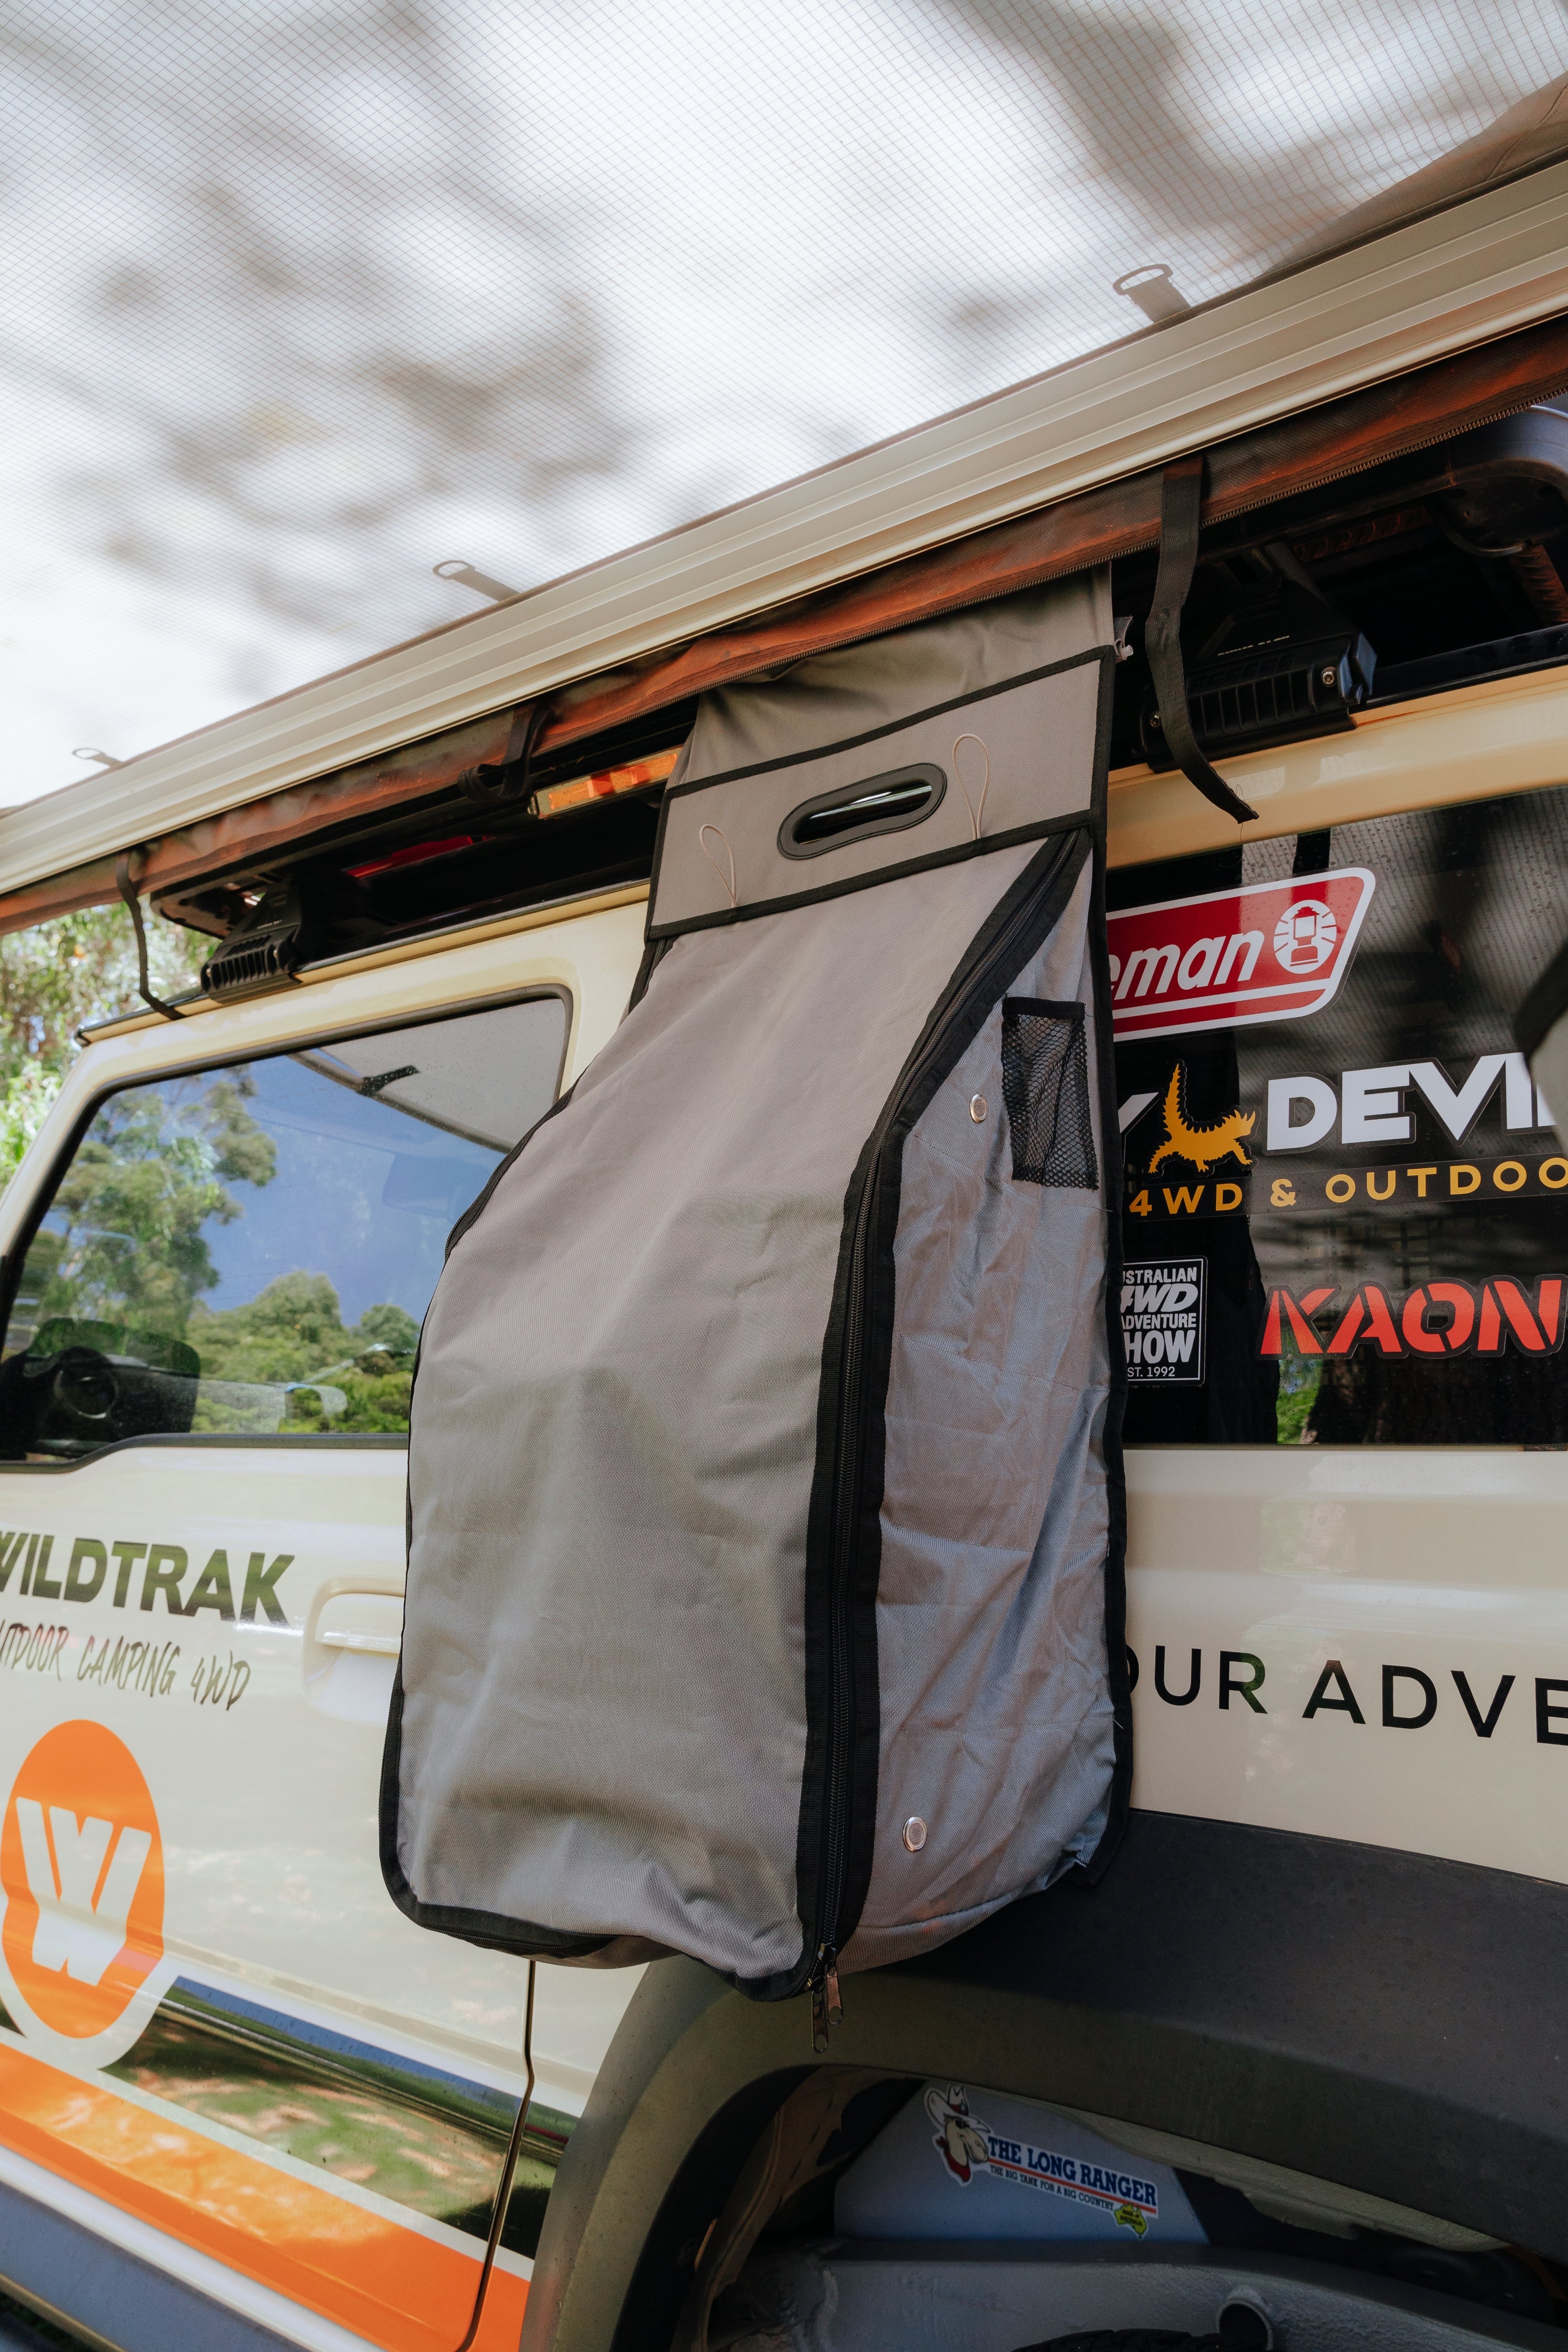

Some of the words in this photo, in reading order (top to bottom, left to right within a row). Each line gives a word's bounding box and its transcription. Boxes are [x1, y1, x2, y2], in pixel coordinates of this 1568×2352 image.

[1129, 1183, 1243, 1216] 4WD
[1270, 1179, 1296, 1207] &
[1325, 1157, 1568, 1203] OUTDOO
[1123, 1267, 1197, 1284] STRALIAN
[1260, 1280, 1562, 1354] KAON
[1124, 1330, 1196, 1364] HOW
[1127, 1367, 1143, 1377] ST.
[1147, 1366, 1175, 1377] 1992
[77, 1636, 180, 1698] CAMPING
[191, 1650, 251, 1711] 4WD
[1126, 1644, 1268, 1714] UR
[1302, 1659, 1568, 1746] ADVE
[988, 2136, 1021, 2165] THE
[1028, 2148, 1077, 2181] LONG
[1081, 2164, 1157, 2206] RANGER
[990, 2165, 1003, 2176] THE
[1005, 2168, 1018, 2181] BIG
[1020, 2173, 1038, 2187] TANK
[1040, 2179, 1055, 2193] FOR
[1056, 2186, 1062, 2195] A
[1064, 2187, 1077, 2200] BIG
[1078, 2192, 1114, 2211] COUNTRY
